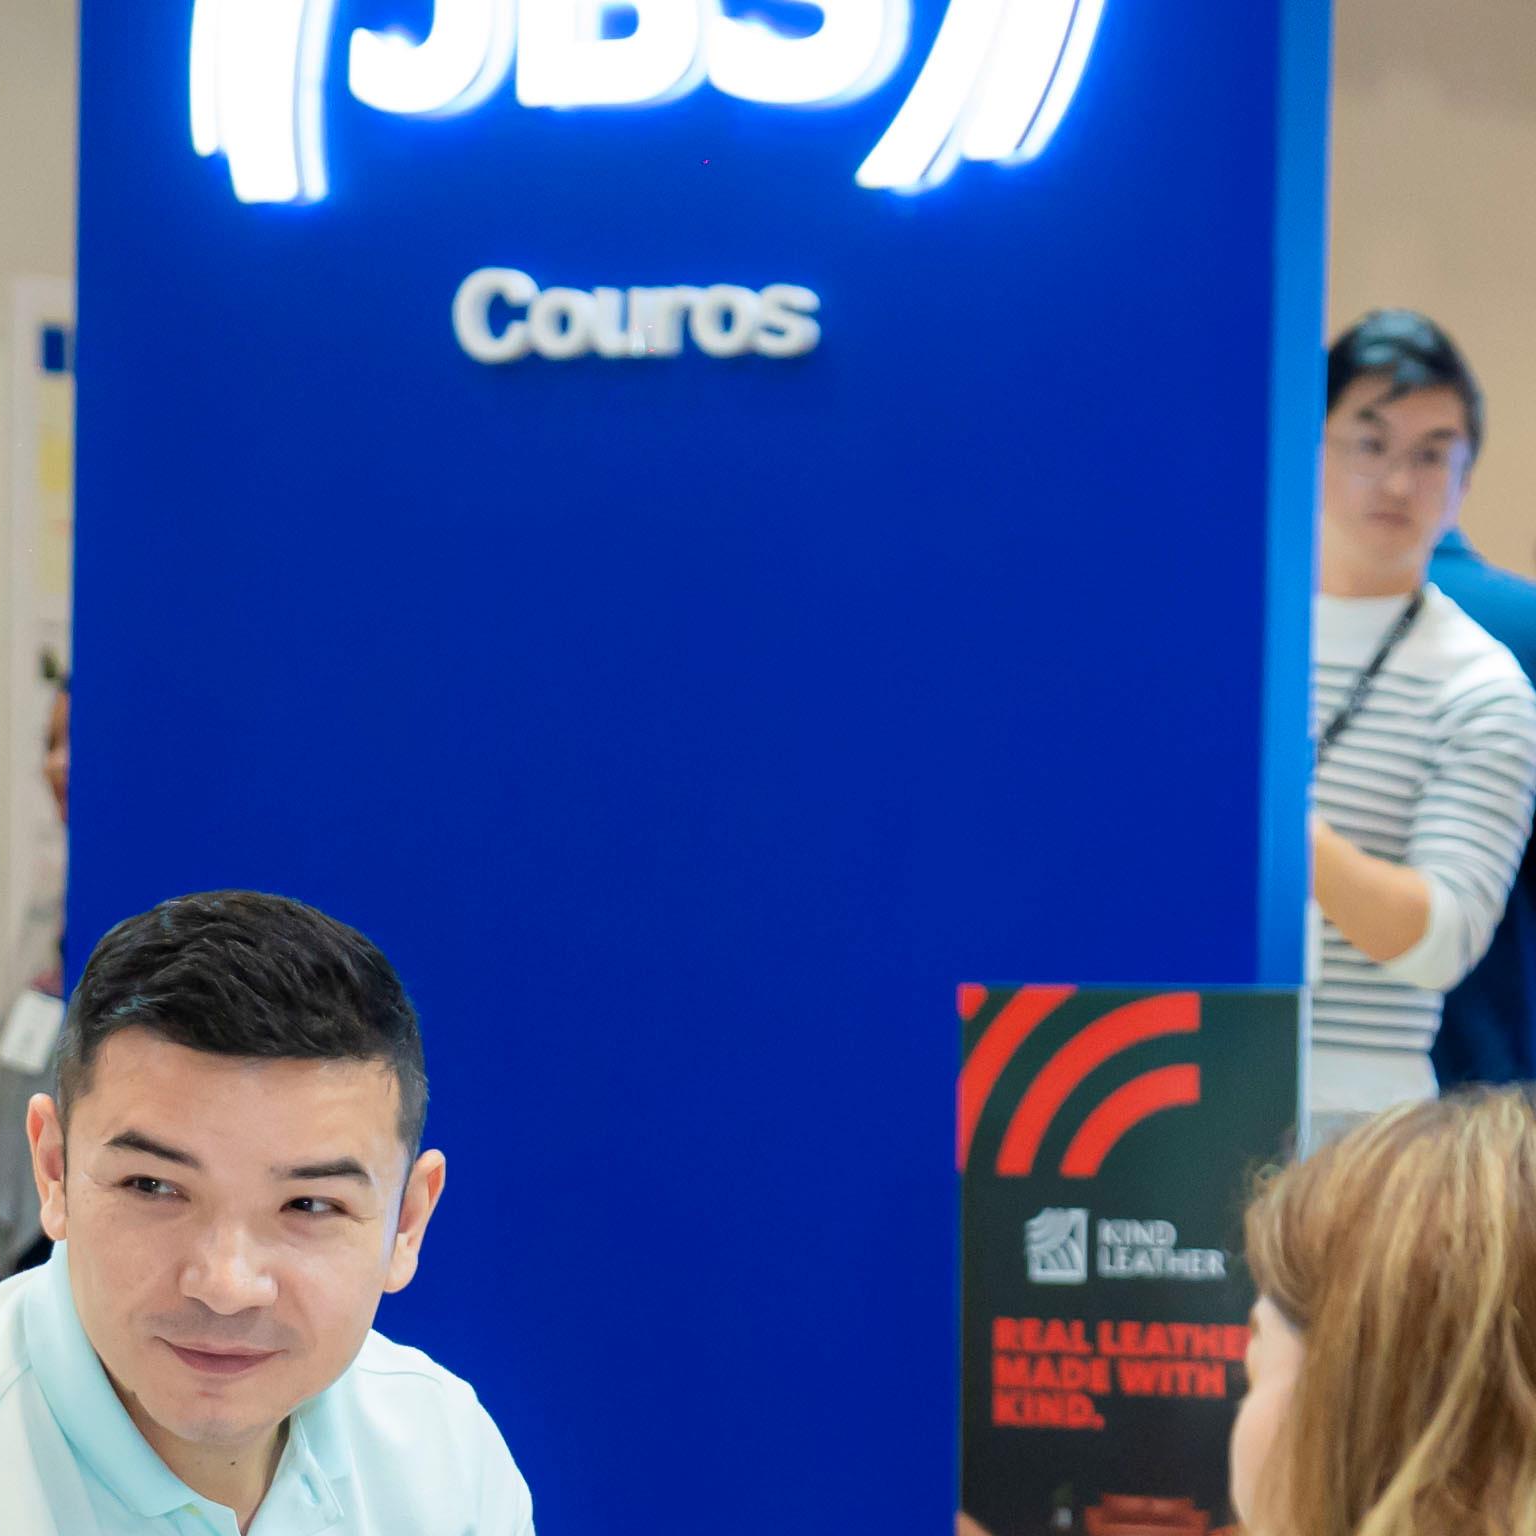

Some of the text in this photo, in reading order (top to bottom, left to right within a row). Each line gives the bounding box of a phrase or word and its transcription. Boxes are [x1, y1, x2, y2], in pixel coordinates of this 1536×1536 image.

[452, 267, 820, 364] Couros
[1098, 1219, 1177, 1245] KIND
[1097, 1246, 1226, 1280] LEATHER
[993, 1318, 1251, 1360] REAL LEATHE
[993, 1355, 1226, 1396] MADE WITH
[993, 1393, 1105, 1429] KIND.
